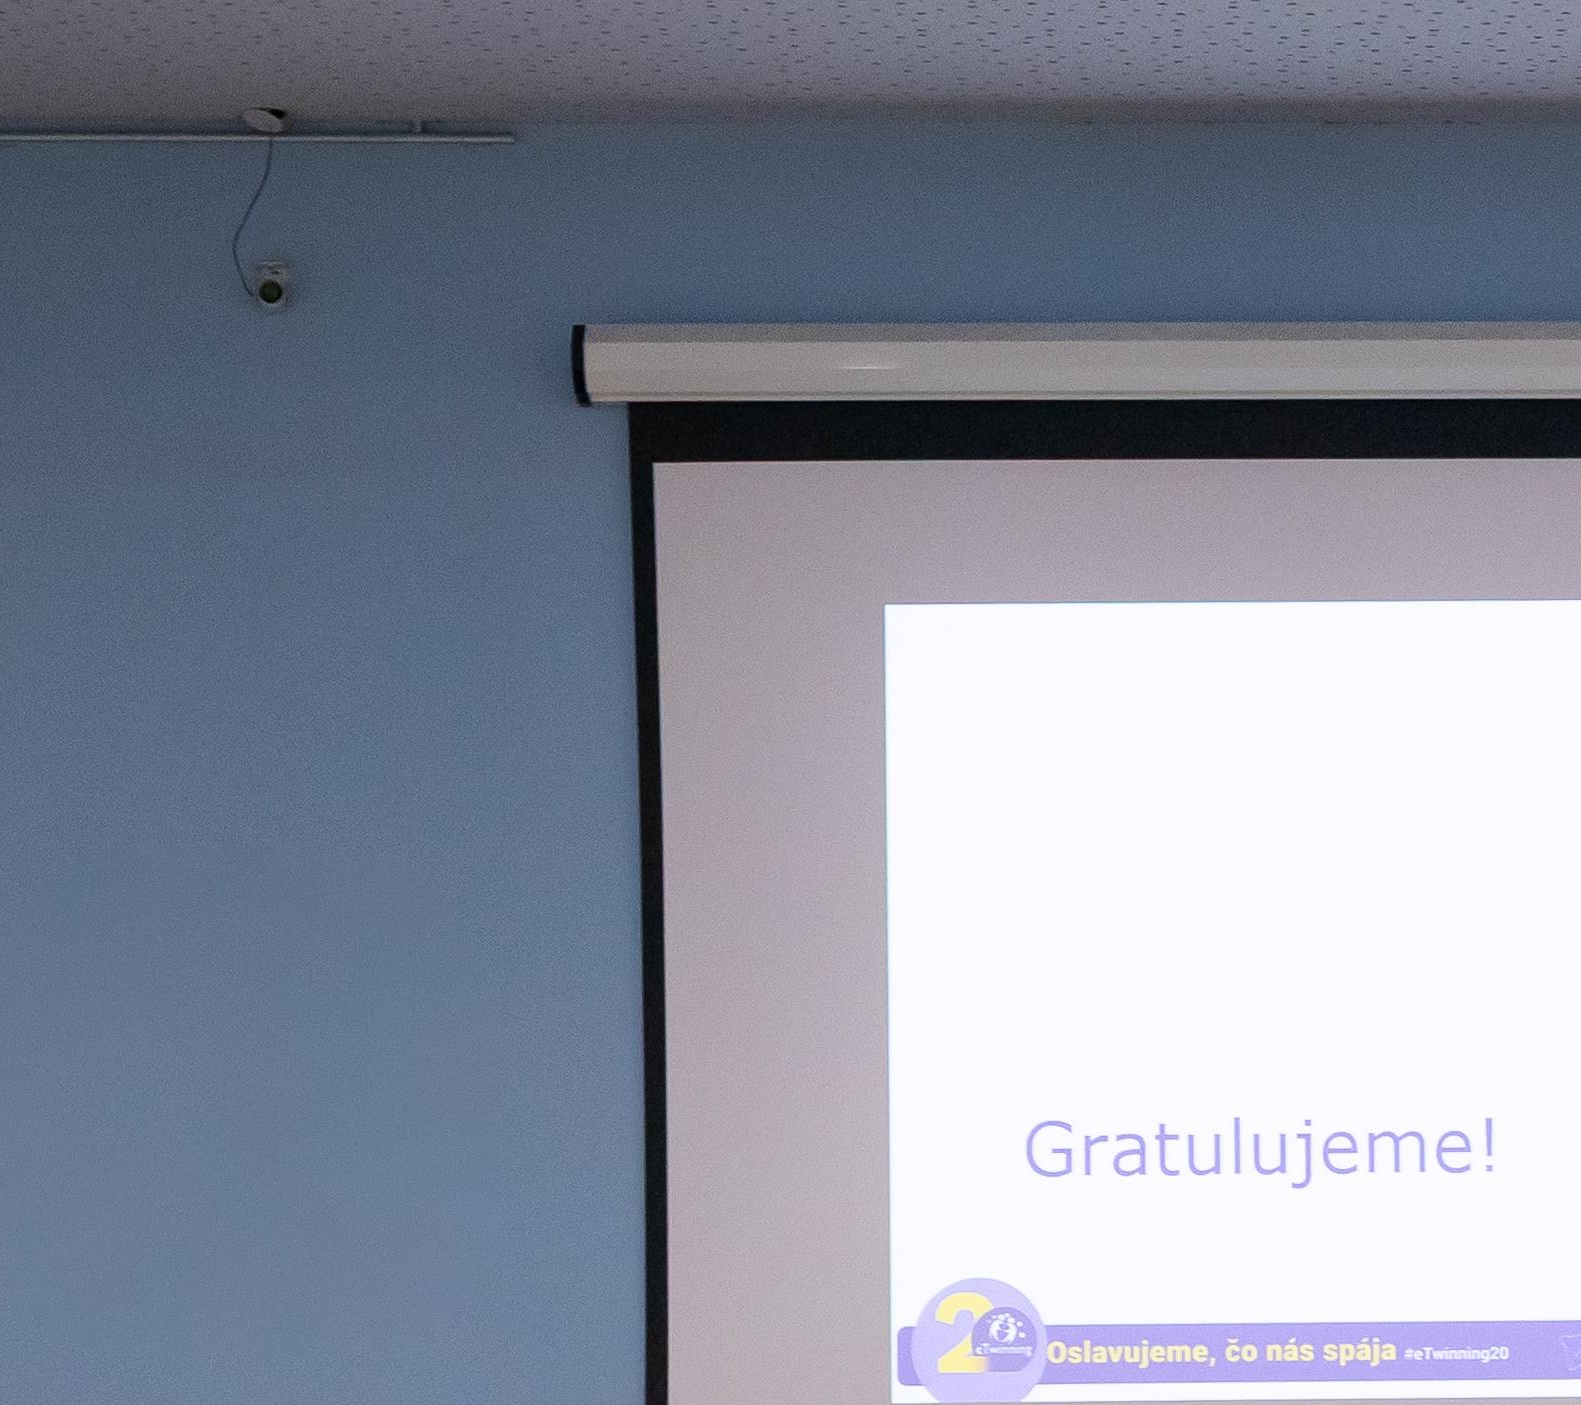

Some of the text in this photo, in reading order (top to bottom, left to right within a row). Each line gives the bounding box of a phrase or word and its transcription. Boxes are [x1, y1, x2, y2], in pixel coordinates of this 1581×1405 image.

[1025, 1116, 1495, 1189] Gratulujeme!
[1046, 1337, 1509, 1369] Oslavujeme, čo nás spája #eTwinning20
